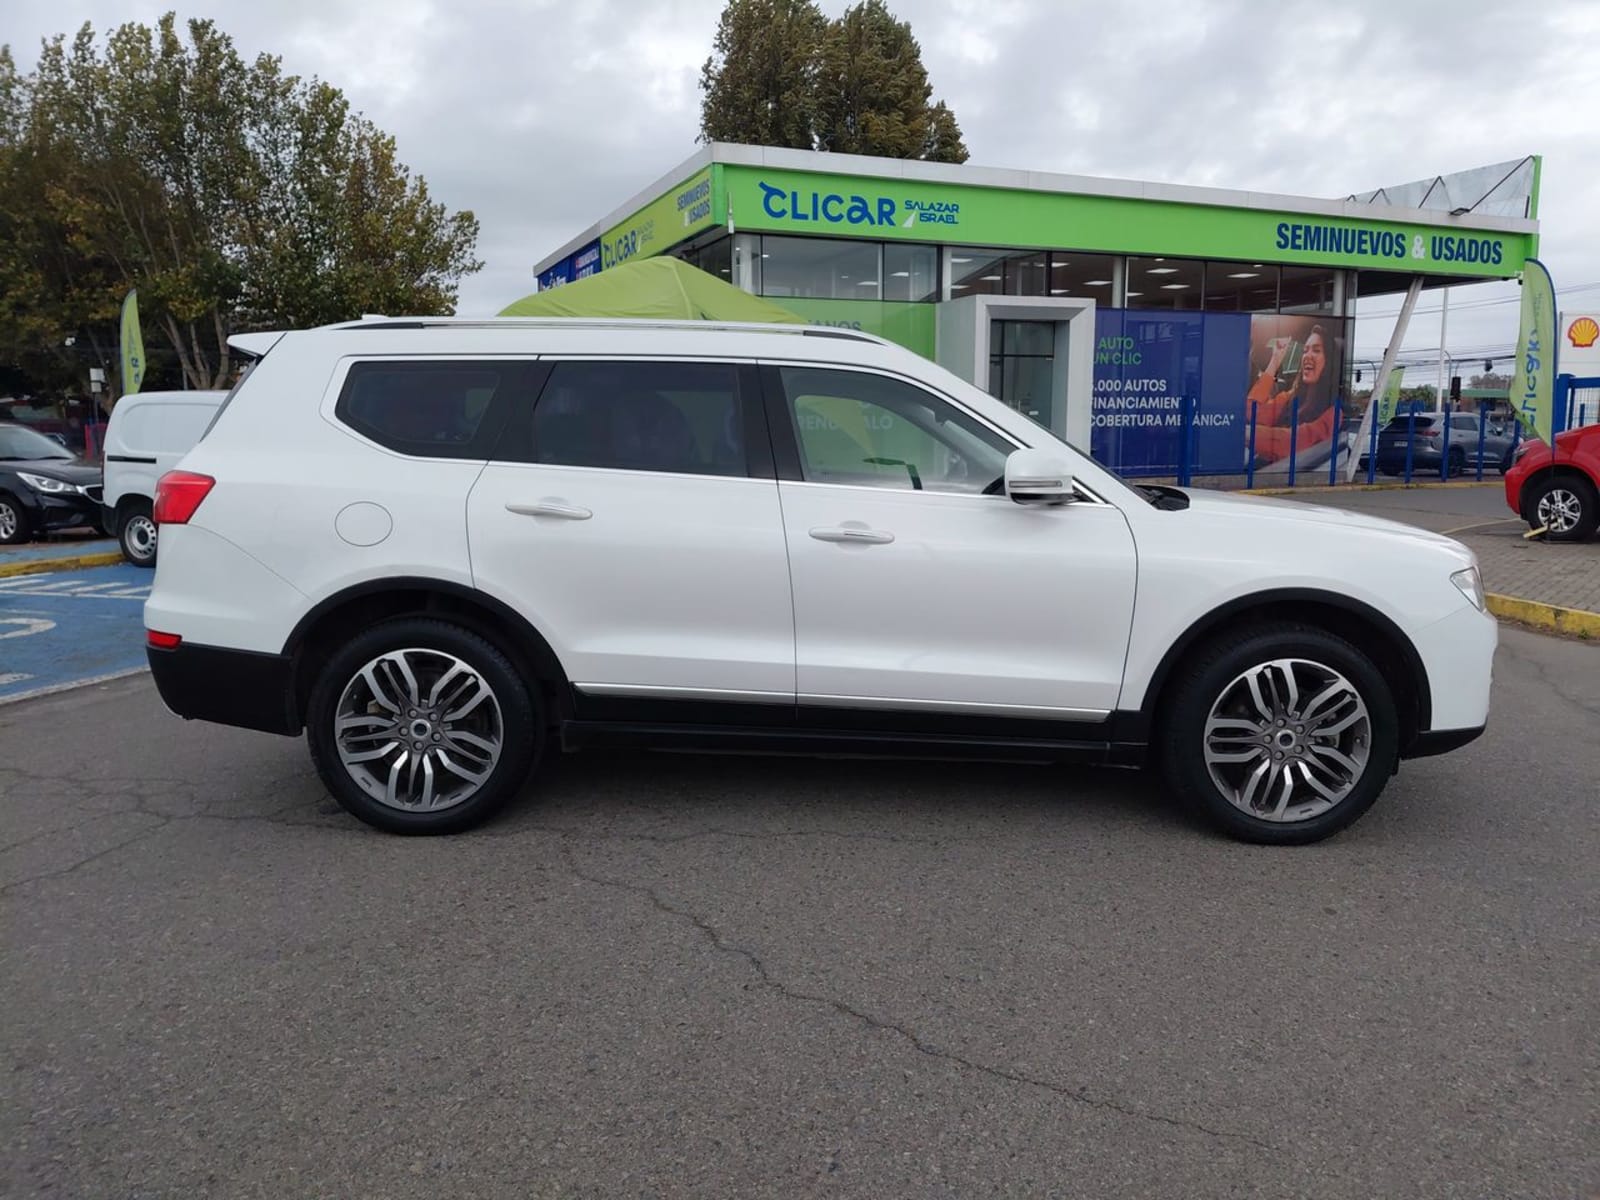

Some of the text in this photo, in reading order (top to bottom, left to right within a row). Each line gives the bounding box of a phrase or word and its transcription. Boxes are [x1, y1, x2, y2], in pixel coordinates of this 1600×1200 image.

[904, 200, 960, 213] SALAZAR
[919, 212, 960, 225] ISRAEL
[1276, 222, 1502, 265] SEMINUEVOS & USADOS
[1098, 336, 1135, 350] AUTO
[1112, 352, 1142, 366] CLIC
[1091, 379, 1167, 392] .000 AUTOS
[1164, 411, 1235, 427] MEÁNICA
